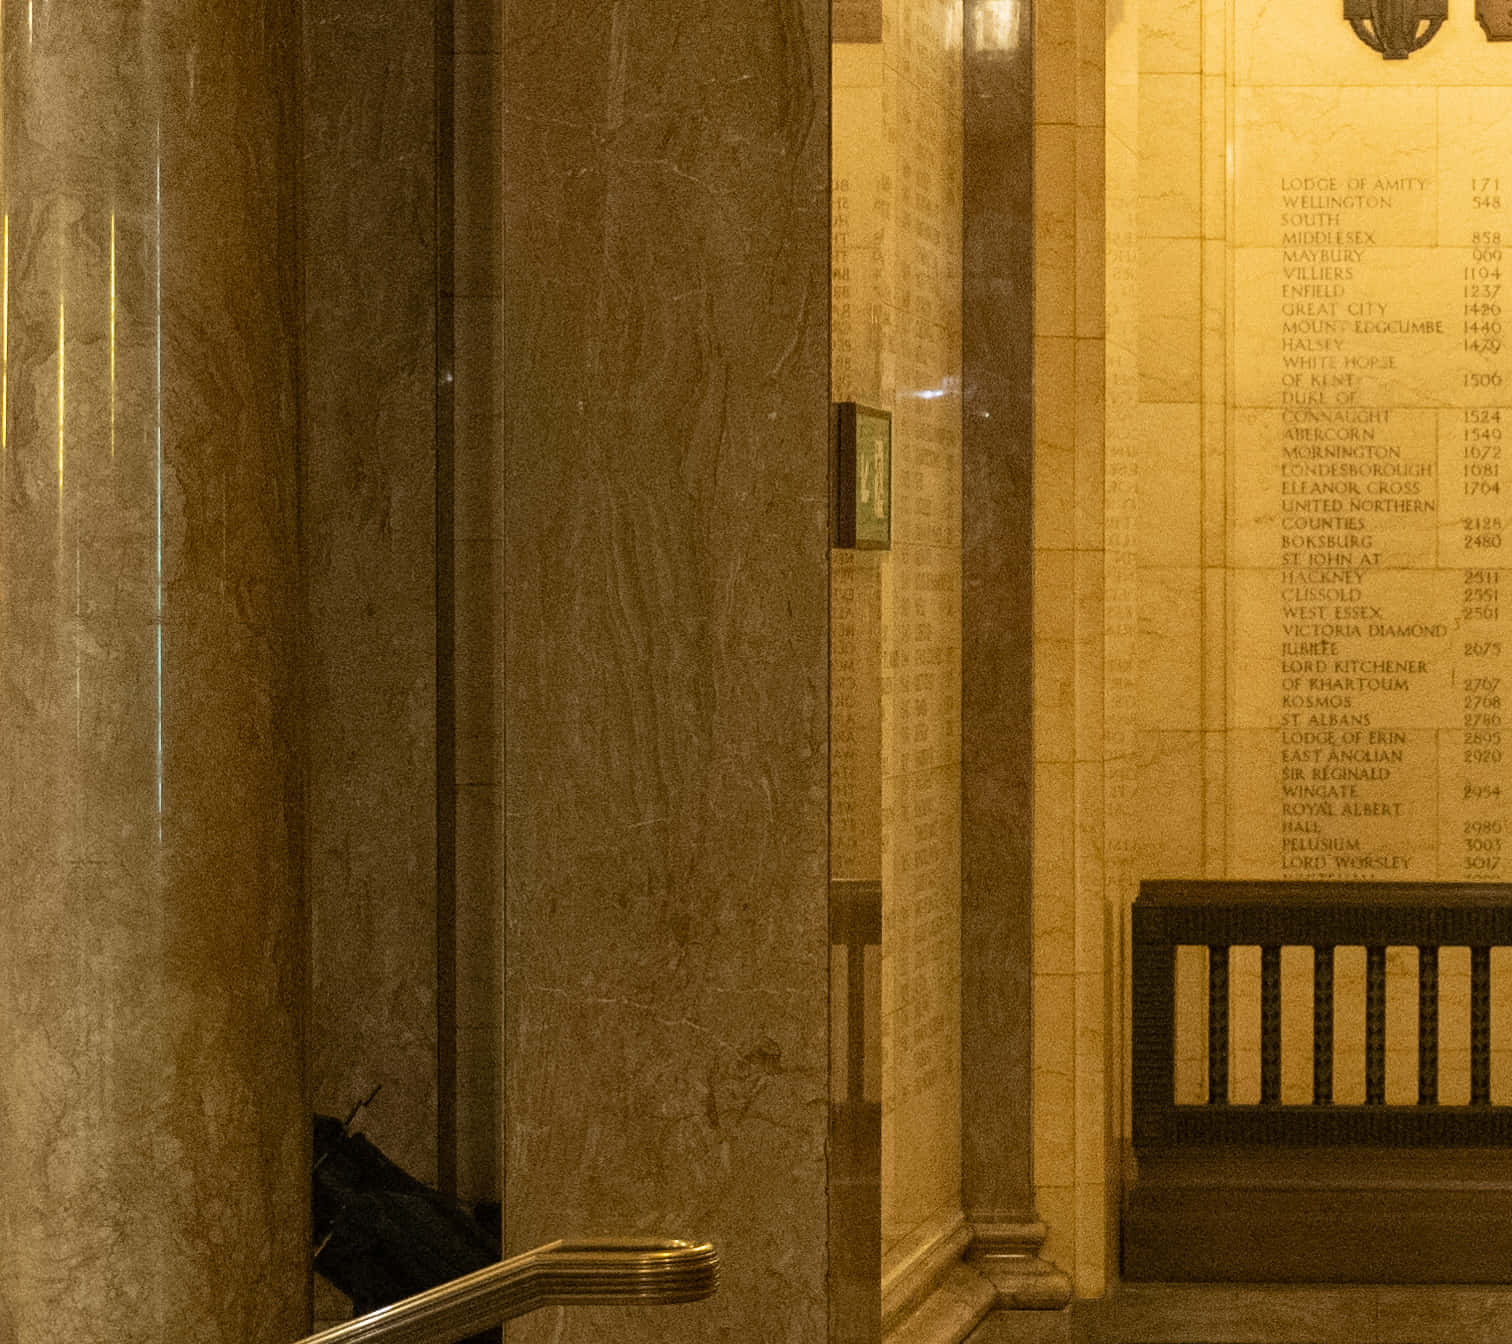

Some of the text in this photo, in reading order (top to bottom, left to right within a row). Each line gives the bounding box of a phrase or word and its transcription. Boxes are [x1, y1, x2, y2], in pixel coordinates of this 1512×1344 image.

[1281, 196, 1392, 210] WELLINGTON
[1281, 284, 1502, 298] ENFIELD 1237
